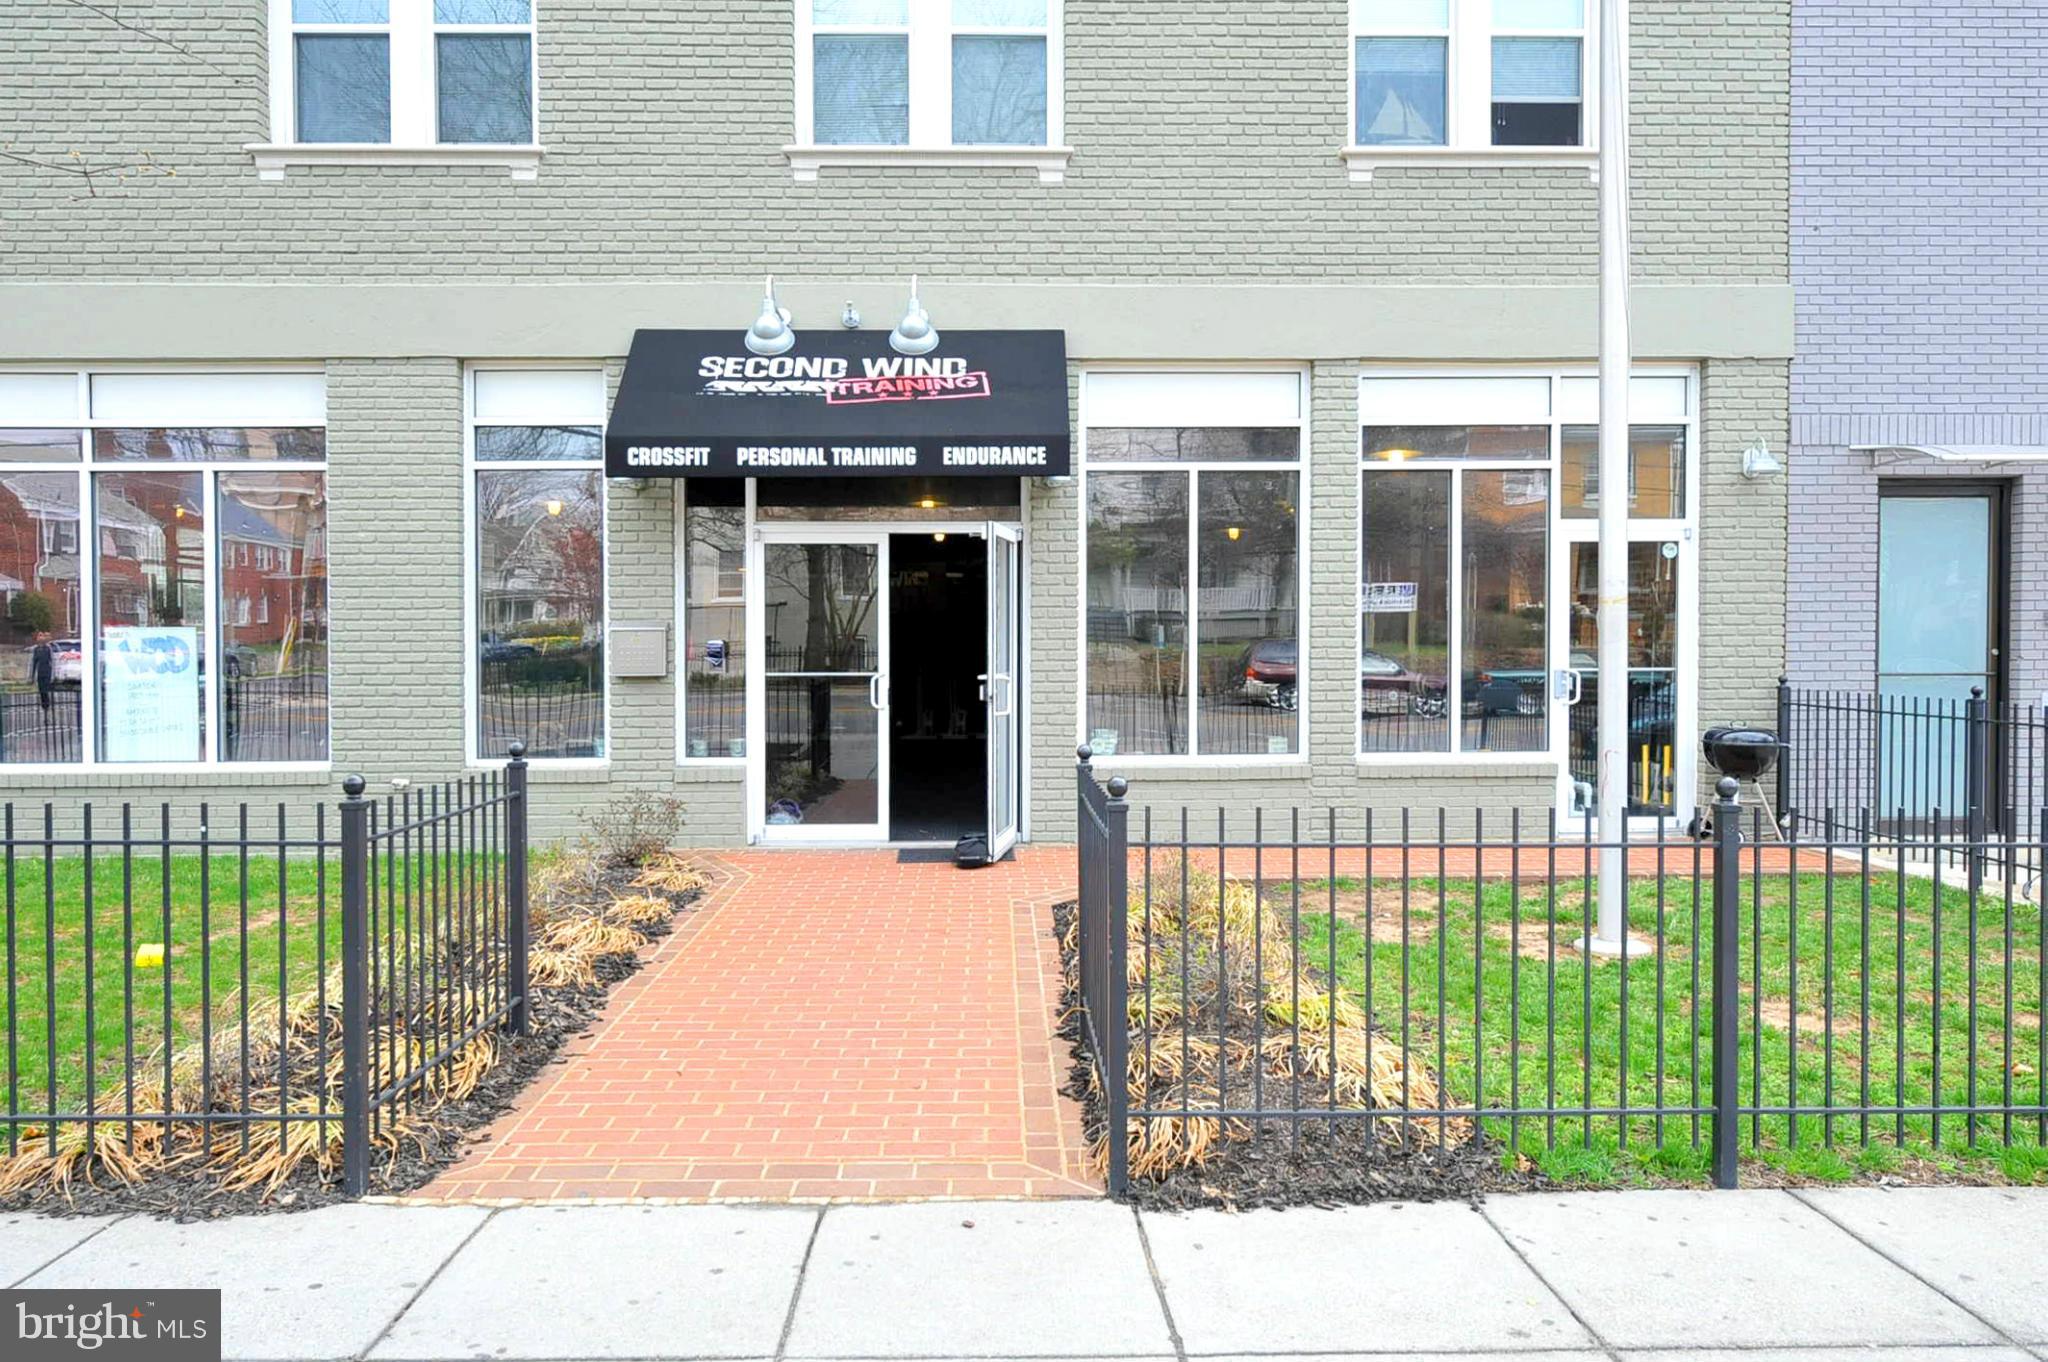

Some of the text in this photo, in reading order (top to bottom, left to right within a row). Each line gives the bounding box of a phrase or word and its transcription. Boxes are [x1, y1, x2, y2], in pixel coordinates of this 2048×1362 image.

[698, 356, 967, 379] SECOND WIND
[832, 375, 980, 395] TRAINING
[627, 447, 711, 466] CROSSFIT
[736, 447, 917, 466] PERSONAL TRAINING
[942, 446, 1047, 466] ENDURANCE
